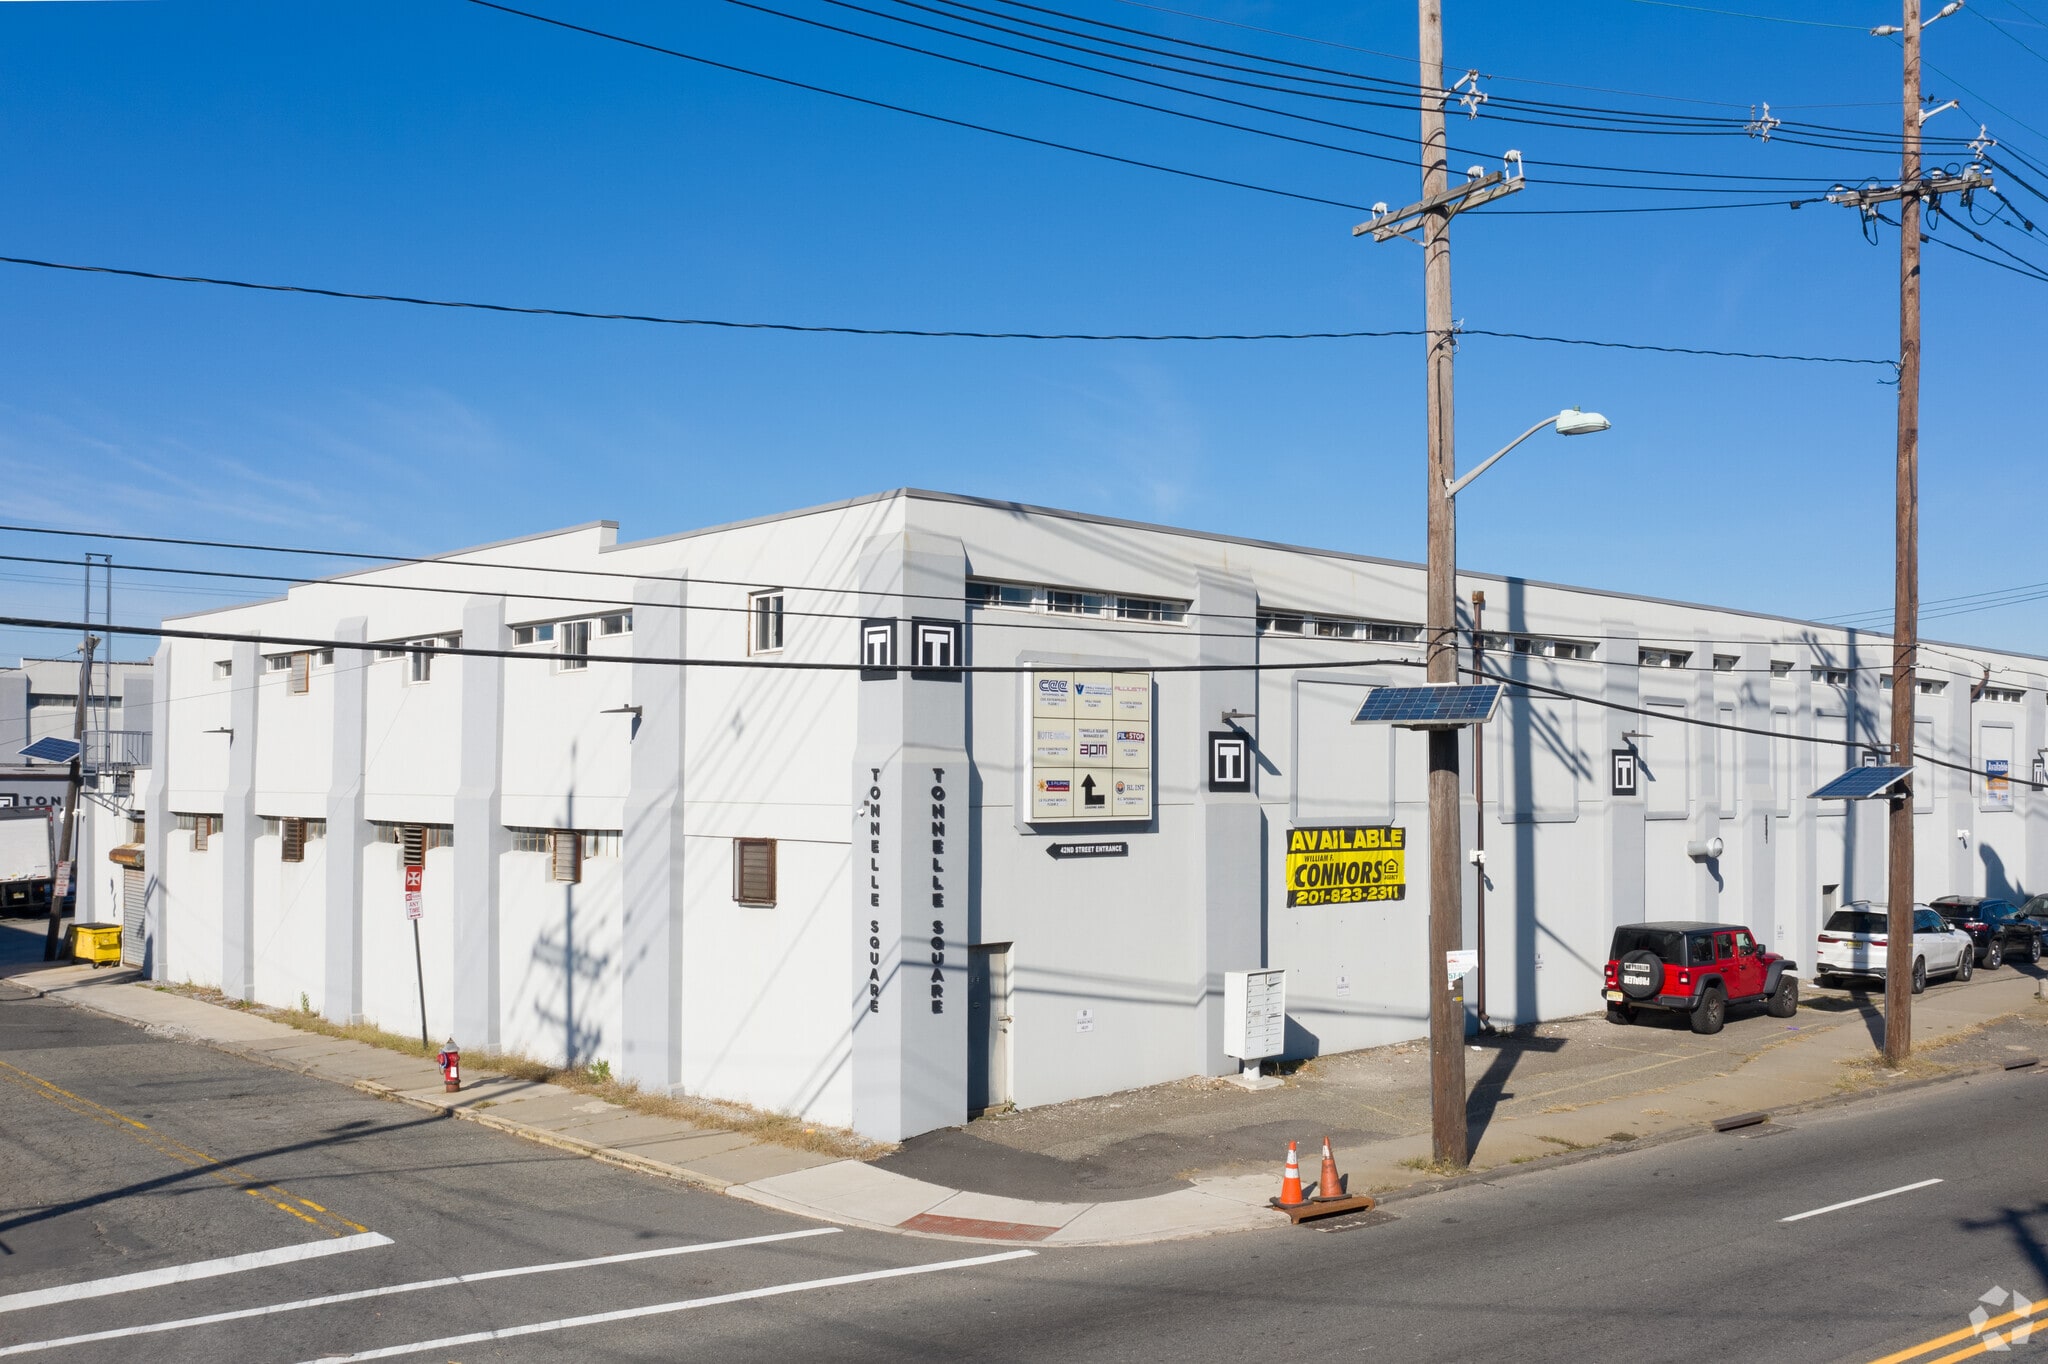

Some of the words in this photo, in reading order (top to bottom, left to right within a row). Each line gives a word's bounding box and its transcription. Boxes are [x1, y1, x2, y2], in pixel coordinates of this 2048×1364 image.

[870, 768, 881, 907] TONNELLE
[931, 768, 946, 908] TONNELLE
[1060, 846, 1074, 854] 42ND
[1075, 845, 1095, 853] STREET
[1095, 845, 1123, 853] ENTRANCE
[1290, 829, 1403, 851] AVAILABLE
[1304, 855, 1329, 863] WILLIAM
[1294, 860, 1382, 888] CONNORS
[1296, 885, 1399, 905] 201-823-2311
[869, 920, 880, 1013] SQUARE
[931, 920, 945, 1014] SQUARE
